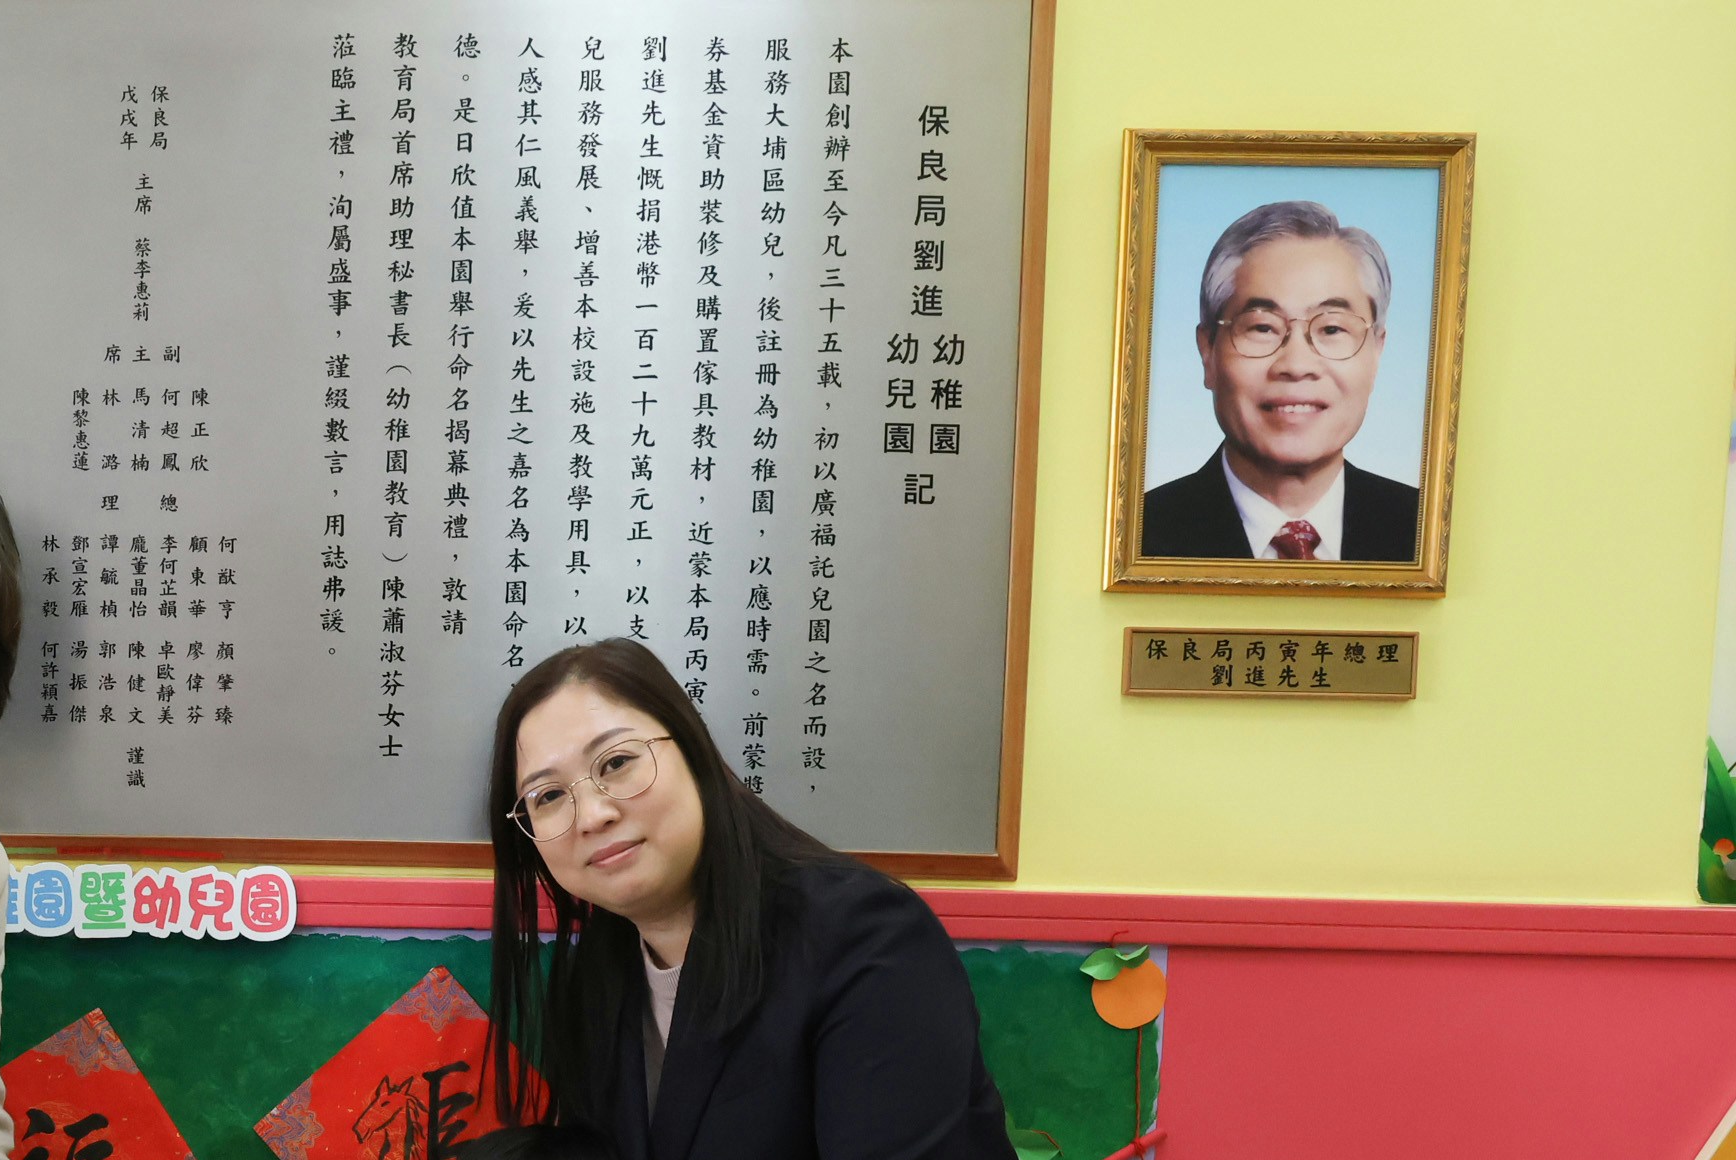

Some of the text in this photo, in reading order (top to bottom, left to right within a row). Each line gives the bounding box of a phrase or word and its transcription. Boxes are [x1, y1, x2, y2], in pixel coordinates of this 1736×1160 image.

[120, 85, 138, 150] 戊戌年
[150, 86, 169, 150] 保良局
[135, 174, 153, 215] 主席
[911, 105, 949, 316] 保良局劉進
[133, 238, 151, 321] 蔡李惠莉
[564, 36, 605, 647] 兒服務發展、增善本校設施及教學用具，以
[684, 36, 730, 706] 券基金資助裝修及購置傢具教材，近蒙本局丙寅
[72, 388, 90, 471] 陳黎惠蓮
[131, 387, 150, 471] 馬清楠
[161, 389, 180, 471] 何超鳳
[190, 388, 210, 471] 陳正欣
[884, 333, 918, 454] 幼兒園
[930, 334, 964, 455] 幼稚園
[904, 474, 935, 504] 記
[42, 535, 60, 617] 林承毅
[71, 536, 89, 617] 鄧宣宏雁
[129, 534, 148, 618] 龐董晶怡
[158, 534, 178, 618] 李何芷韻
[188, 536, 208, 618] 顧東華
[69, 641, 88, 723] 湯振傑
[99, 640, 117, 723] 郭浩泉
[127, 641, 146, 724] 陳健文
[156, 640, 175, 724] 卓歐靜美
[186, 641, 205, 724] 廖偉芬
[215, 641, 234, 725] 顏肇臻
[1145, 637, 1400, 664] 保良局丙寅年總理
[1210, 664, 1332, 688] 劉進先生
[126, 747, 145, 788] 謹識
